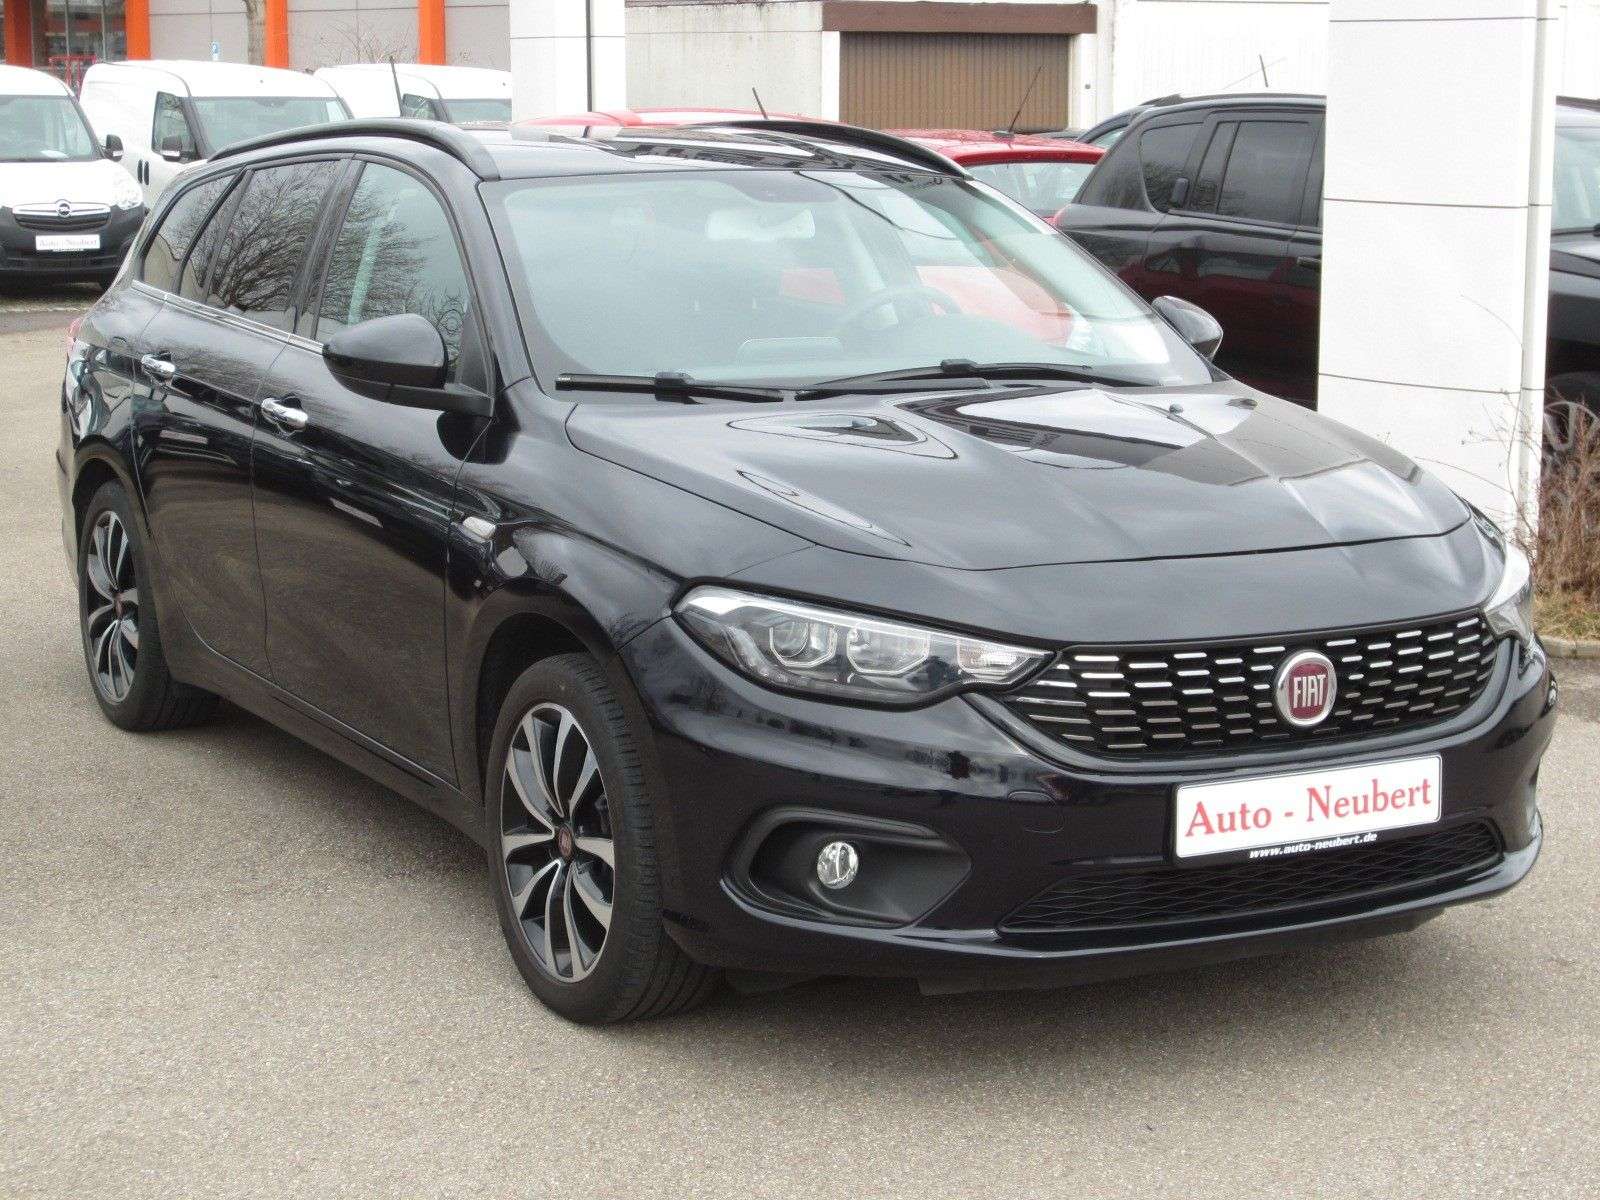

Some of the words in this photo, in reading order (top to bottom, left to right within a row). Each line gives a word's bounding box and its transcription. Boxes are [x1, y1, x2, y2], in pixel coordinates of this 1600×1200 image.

[1293, 674, 1326, 709] FIAT
[1185, 801, 1272, 837] Auto
[1306, 778, 1432, 822] Neubert
[1249, 832, 1378, 859] www.auto-neubert.de
